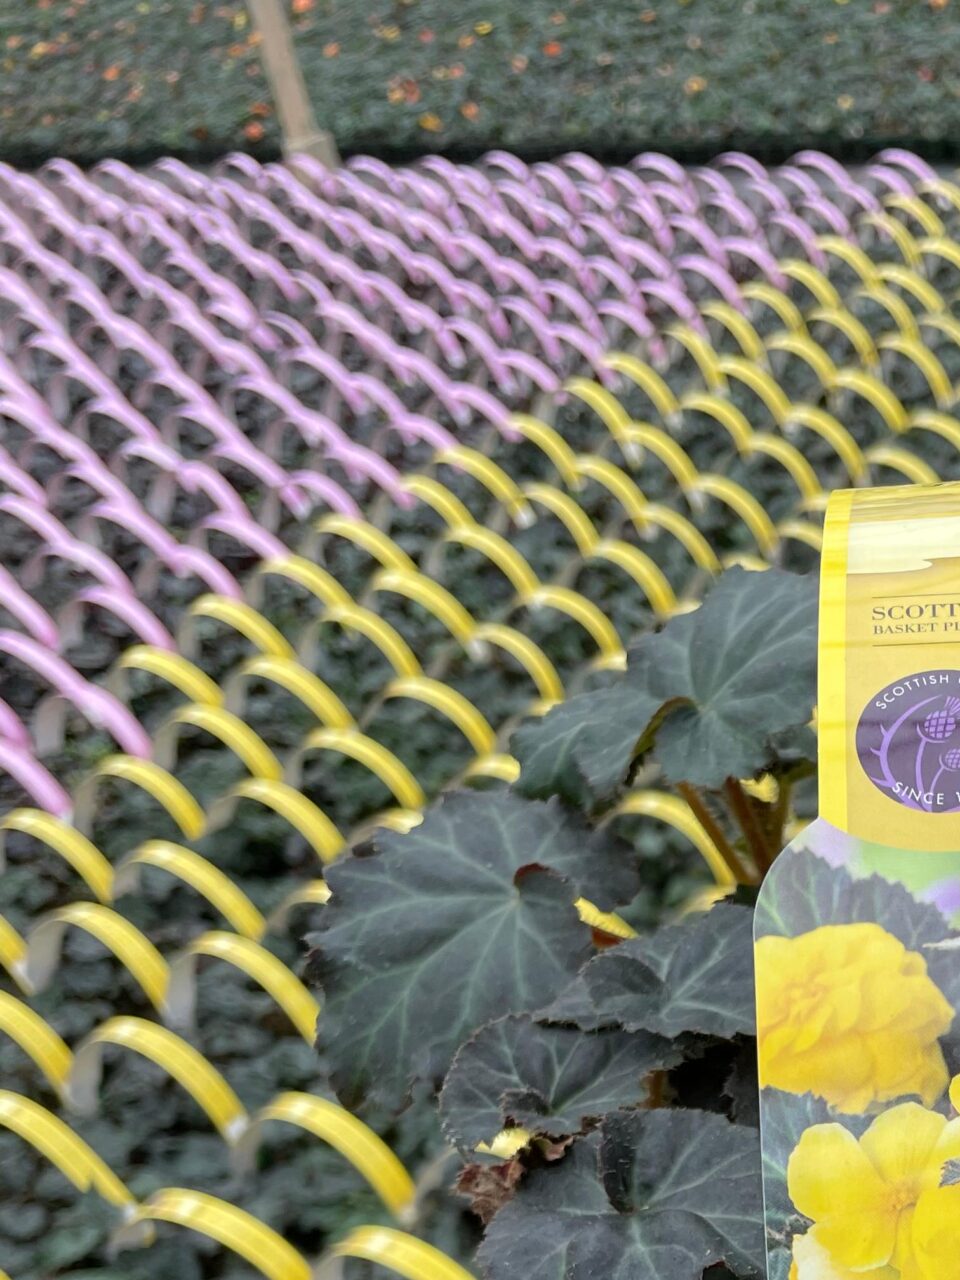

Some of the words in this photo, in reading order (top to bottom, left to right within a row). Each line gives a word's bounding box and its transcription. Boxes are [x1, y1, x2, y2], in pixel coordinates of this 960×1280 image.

[874, 622, 936, 635] BASKET
[876, 674, 950, 710] SCOTTISH
[891, 781, 945, 805] SINCE
